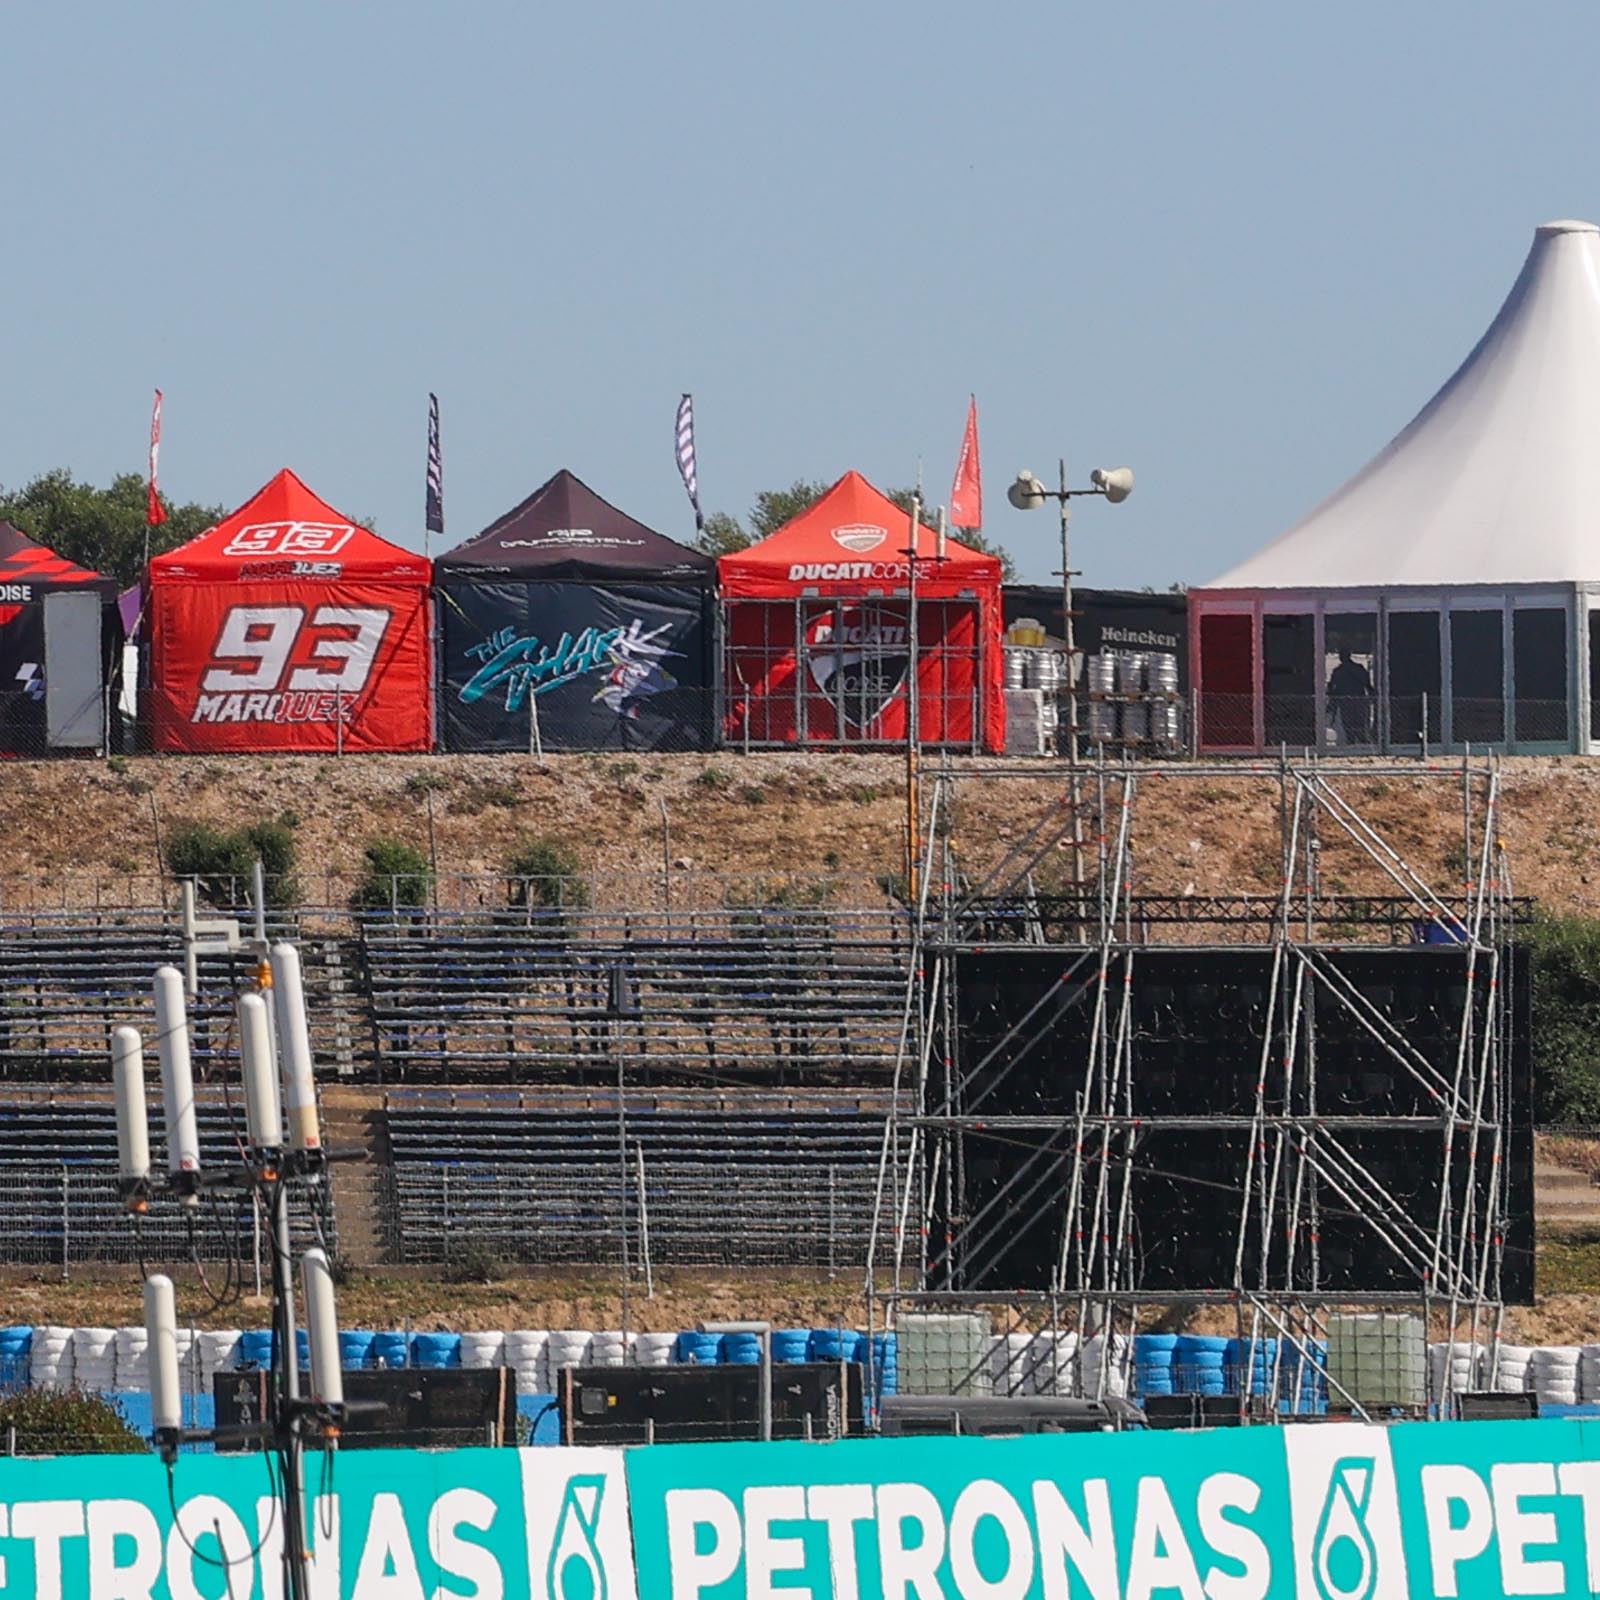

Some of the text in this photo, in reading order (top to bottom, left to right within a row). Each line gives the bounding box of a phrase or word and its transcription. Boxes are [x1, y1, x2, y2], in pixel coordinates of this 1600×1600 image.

[223, 520, 355, 555] 93
[202, 605, 392, 692] 93
[1101, 627, 1177, 647] Heineken
[665, 1472, 1272, 1600] PETRONAS
